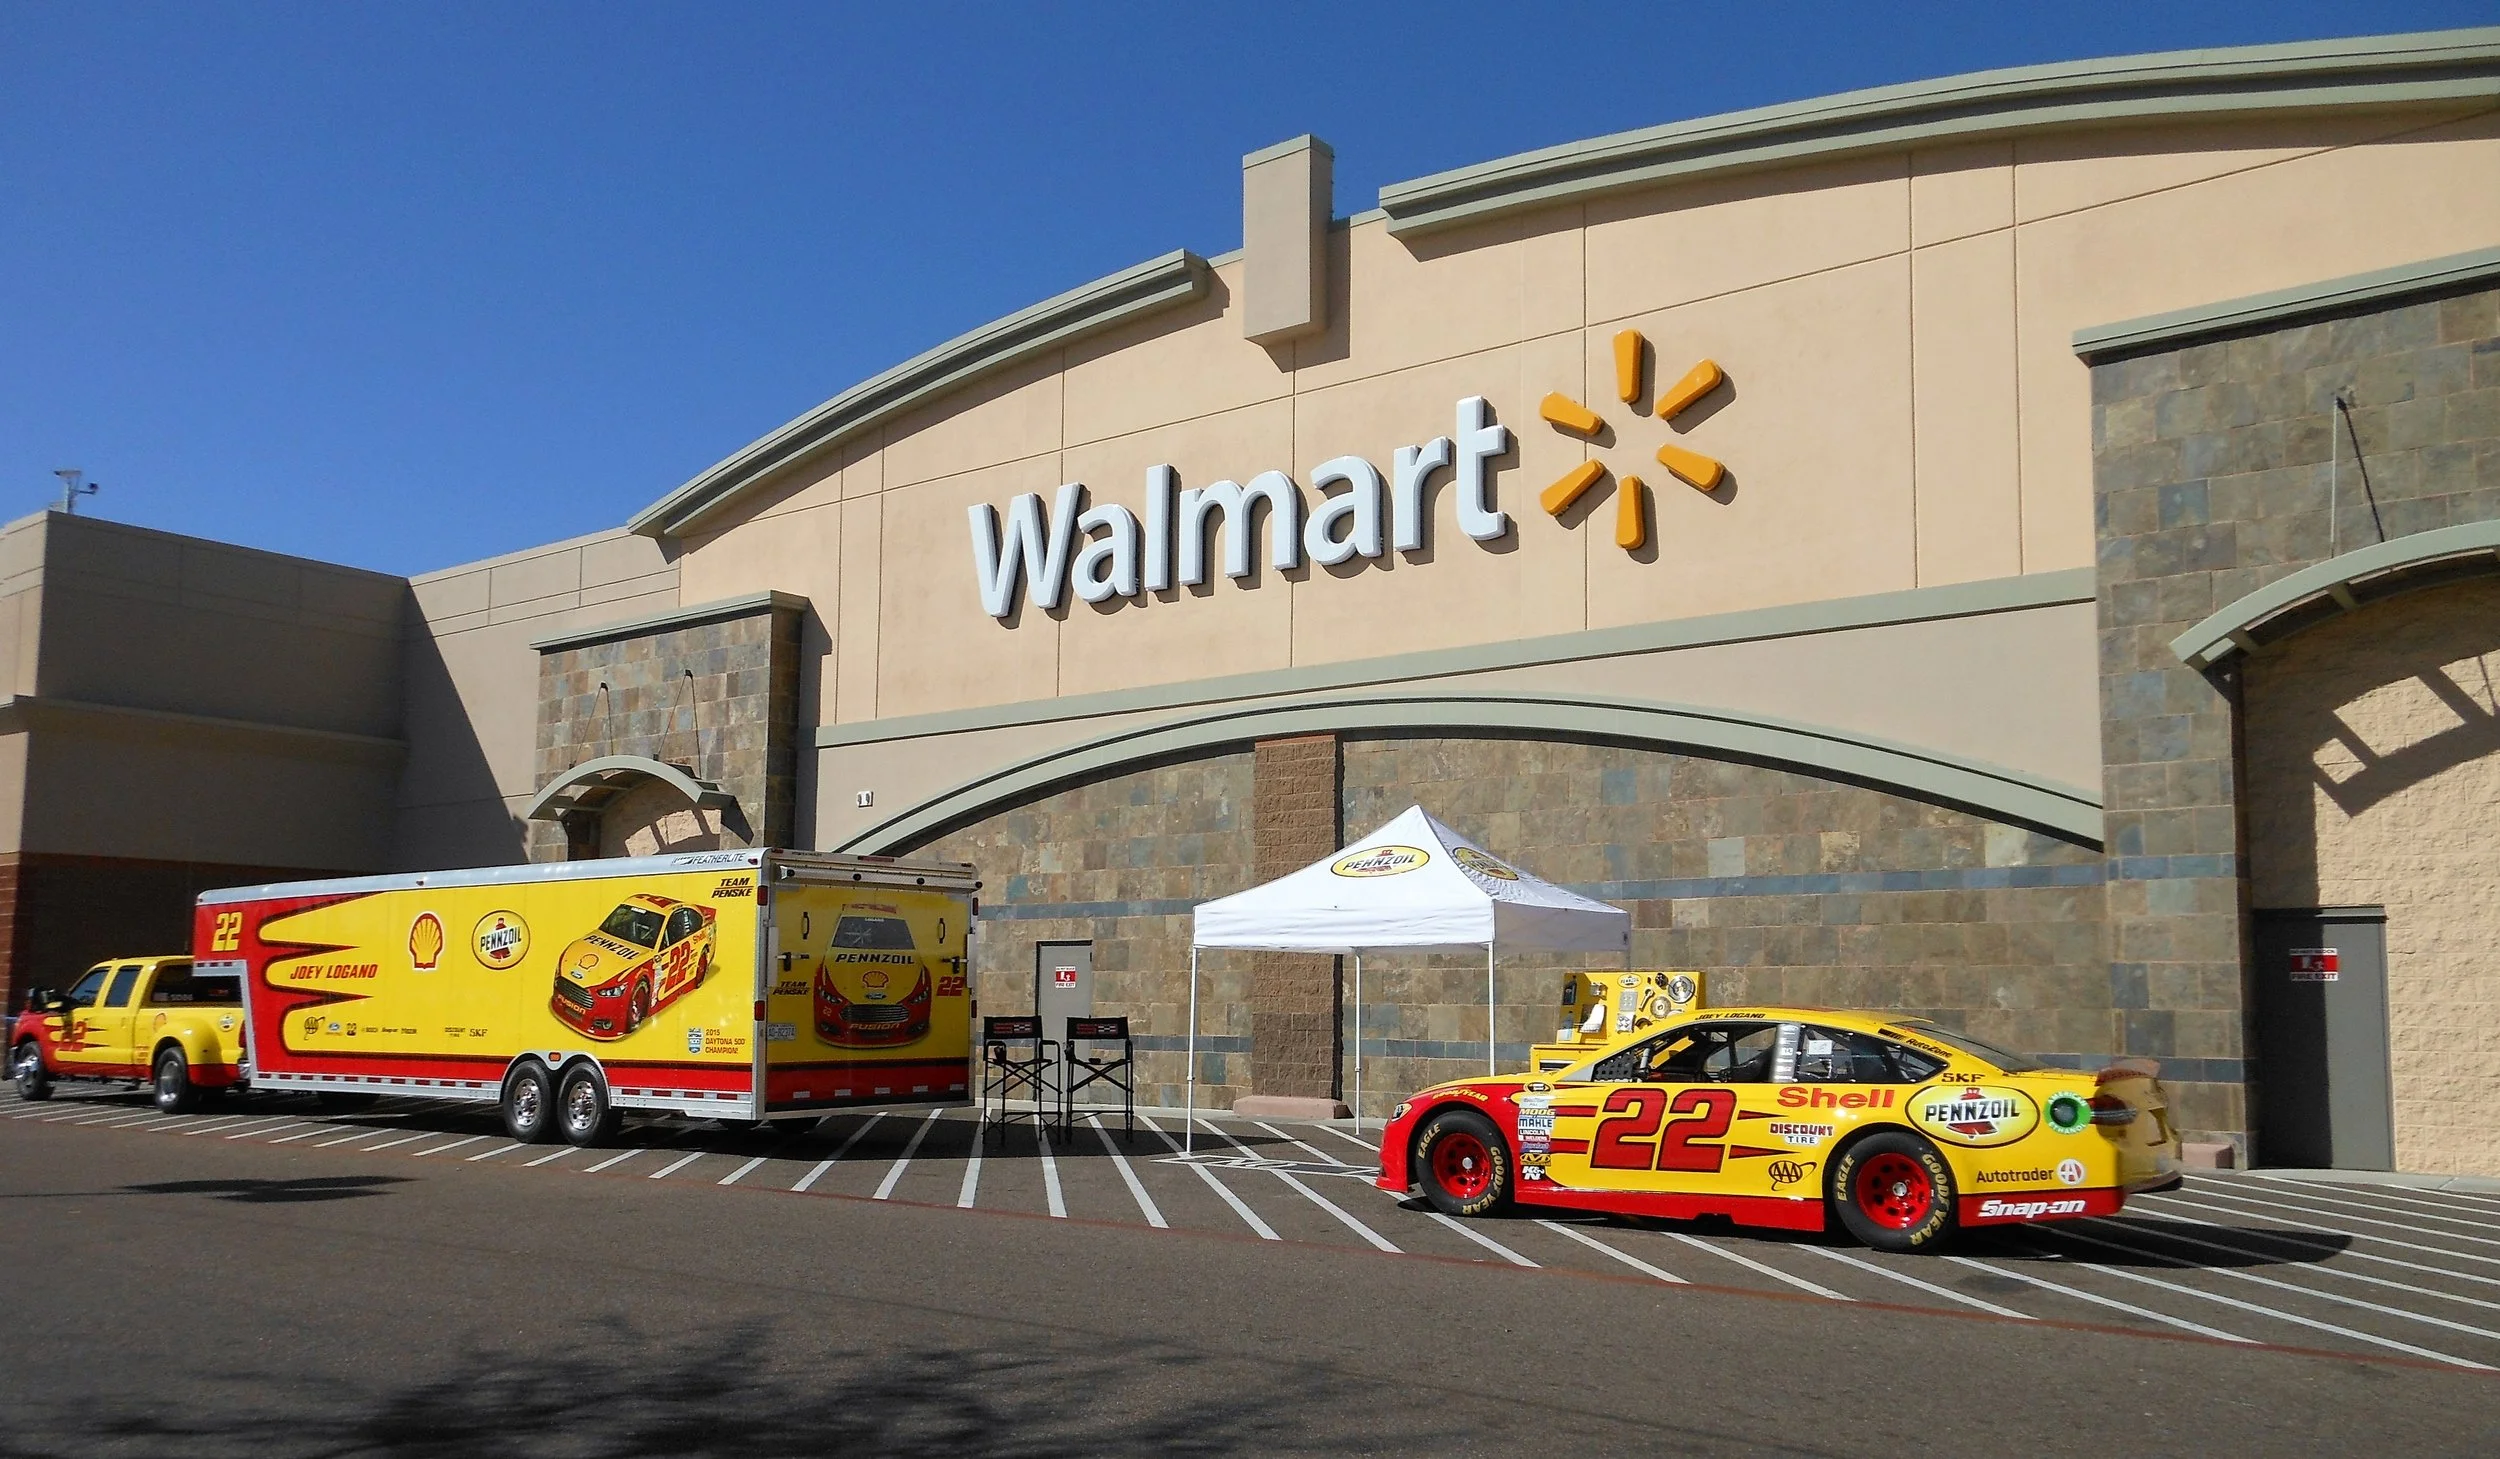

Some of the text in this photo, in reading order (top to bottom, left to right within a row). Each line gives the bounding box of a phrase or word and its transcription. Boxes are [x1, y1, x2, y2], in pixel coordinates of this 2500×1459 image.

[967, 395, 1509, 617] Walmart
[692, 852, 746, 864] FEATHERLITE
[1342, 854, 1416, 871] PENNZOIL
[720, 877, 750, 886] TEAM
[712, 888, 753, 898] PENSKE
[211, 911, 242, 951] 22
[480, 926, 521, 952] PENNZOIL
[583, 934, 640, 960] PENNZOIL
[664, 940, 691, 993] 22
[835, 953, 915, 965] PENNZOIL
[290, 964, 378, 979] JOEY LOGANO
[936, 976, 965, 996] 22
[469, 1029, 488, 1037] SKF
[1906, 1038, 1952, 1058] AutoZone
[1942, 1073, 1986, 1083] SKF
[1432, 1089, 1489, 1102] GOODYEAR
[1776, 1086, 1895, 1109] Shell
[1925, 1099, 2020, 1122] PENNZOIL
[1519, 1118, 1552, 1127] MAHLE
[1590, 1088, 1738, 1173] 22
[1769, 1123, 1834, 1136] DISCOUNT
[1418, 1122, 1441, 1159] EAGLE
[1787, 1136, 1815, 1144] TIRE
[1770, 1161, 1802, 1183] AAA
[1837, 1154, 1855, 1201] EAGLE
[1976, 1168, 2054, 1184] Autotrader
[1978, 1199, 2087, 1219] Snap-on
